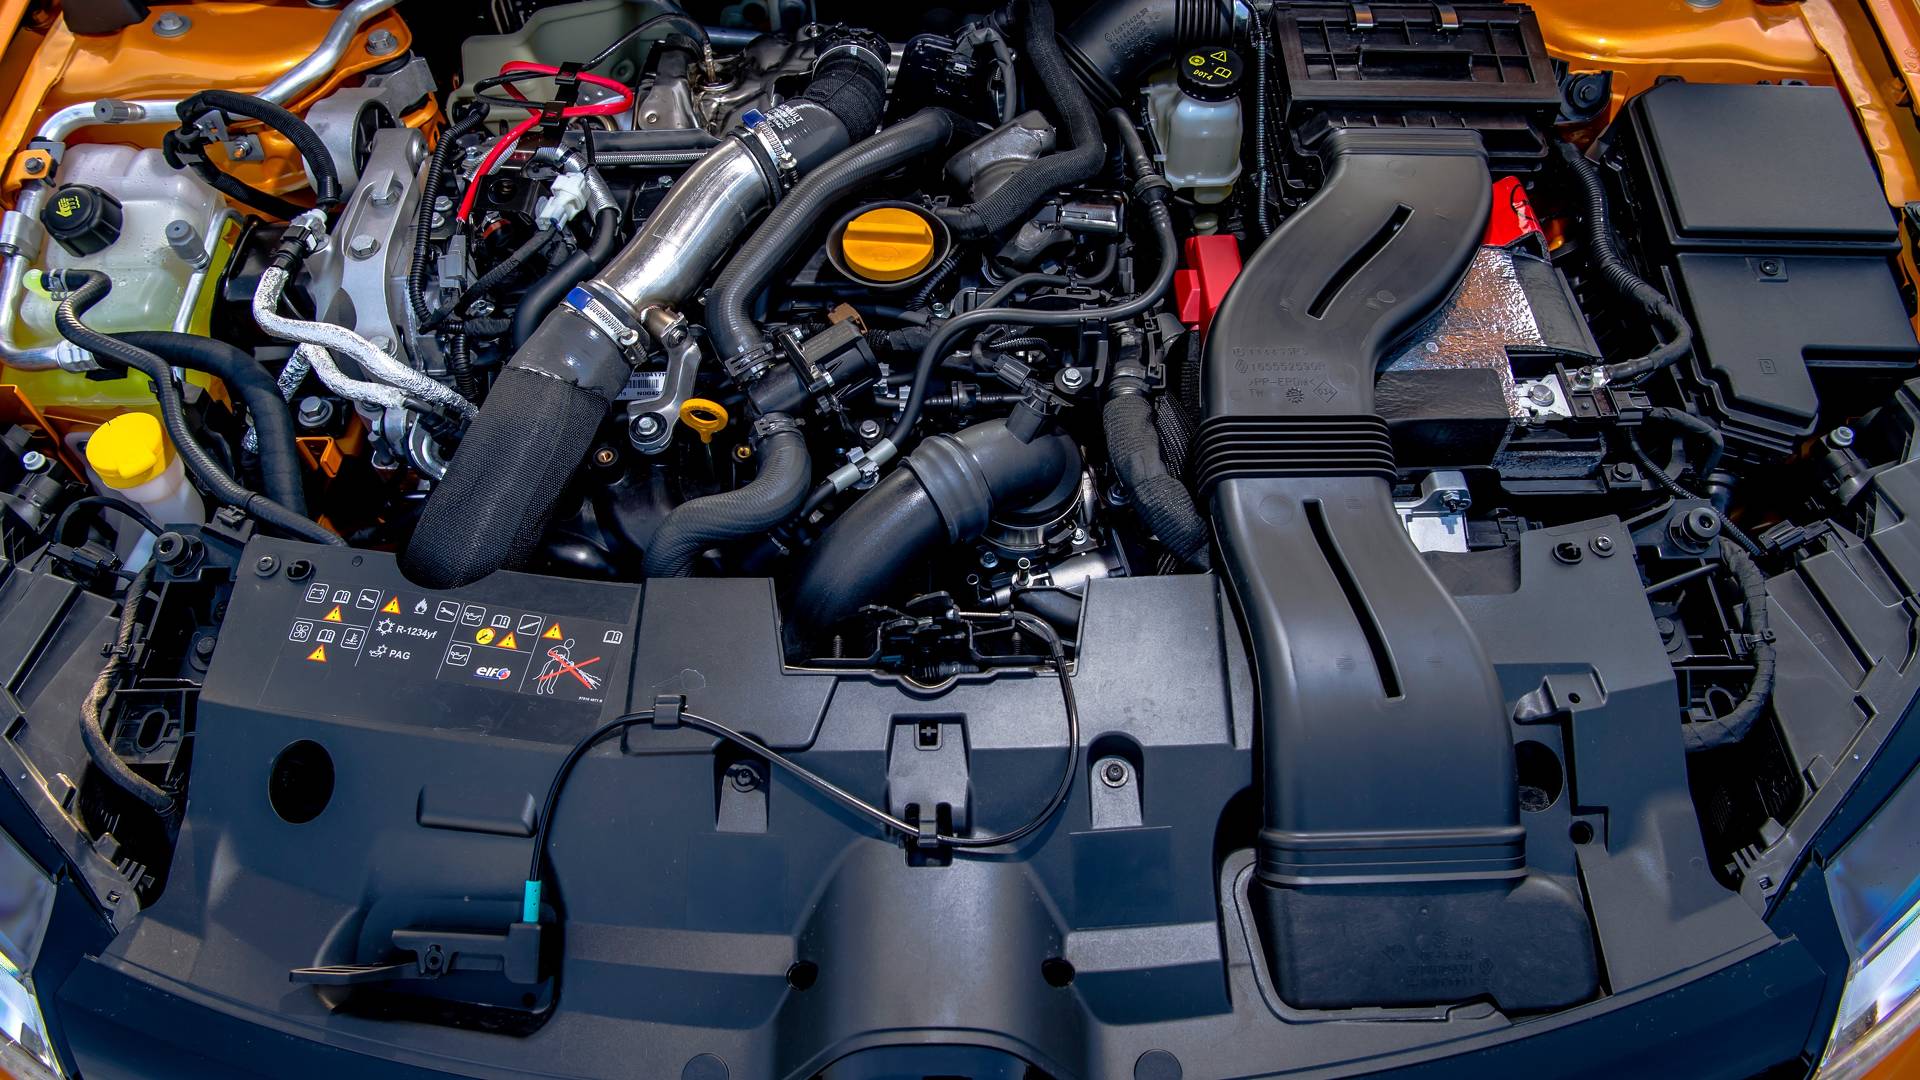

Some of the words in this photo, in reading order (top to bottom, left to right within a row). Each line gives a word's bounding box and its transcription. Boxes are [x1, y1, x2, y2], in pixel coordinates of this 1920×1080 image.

[396, 628, 438, 639] R-1234yf
[388, 649, 411, 660] PAG
[475, 667, 498, 677] elf
